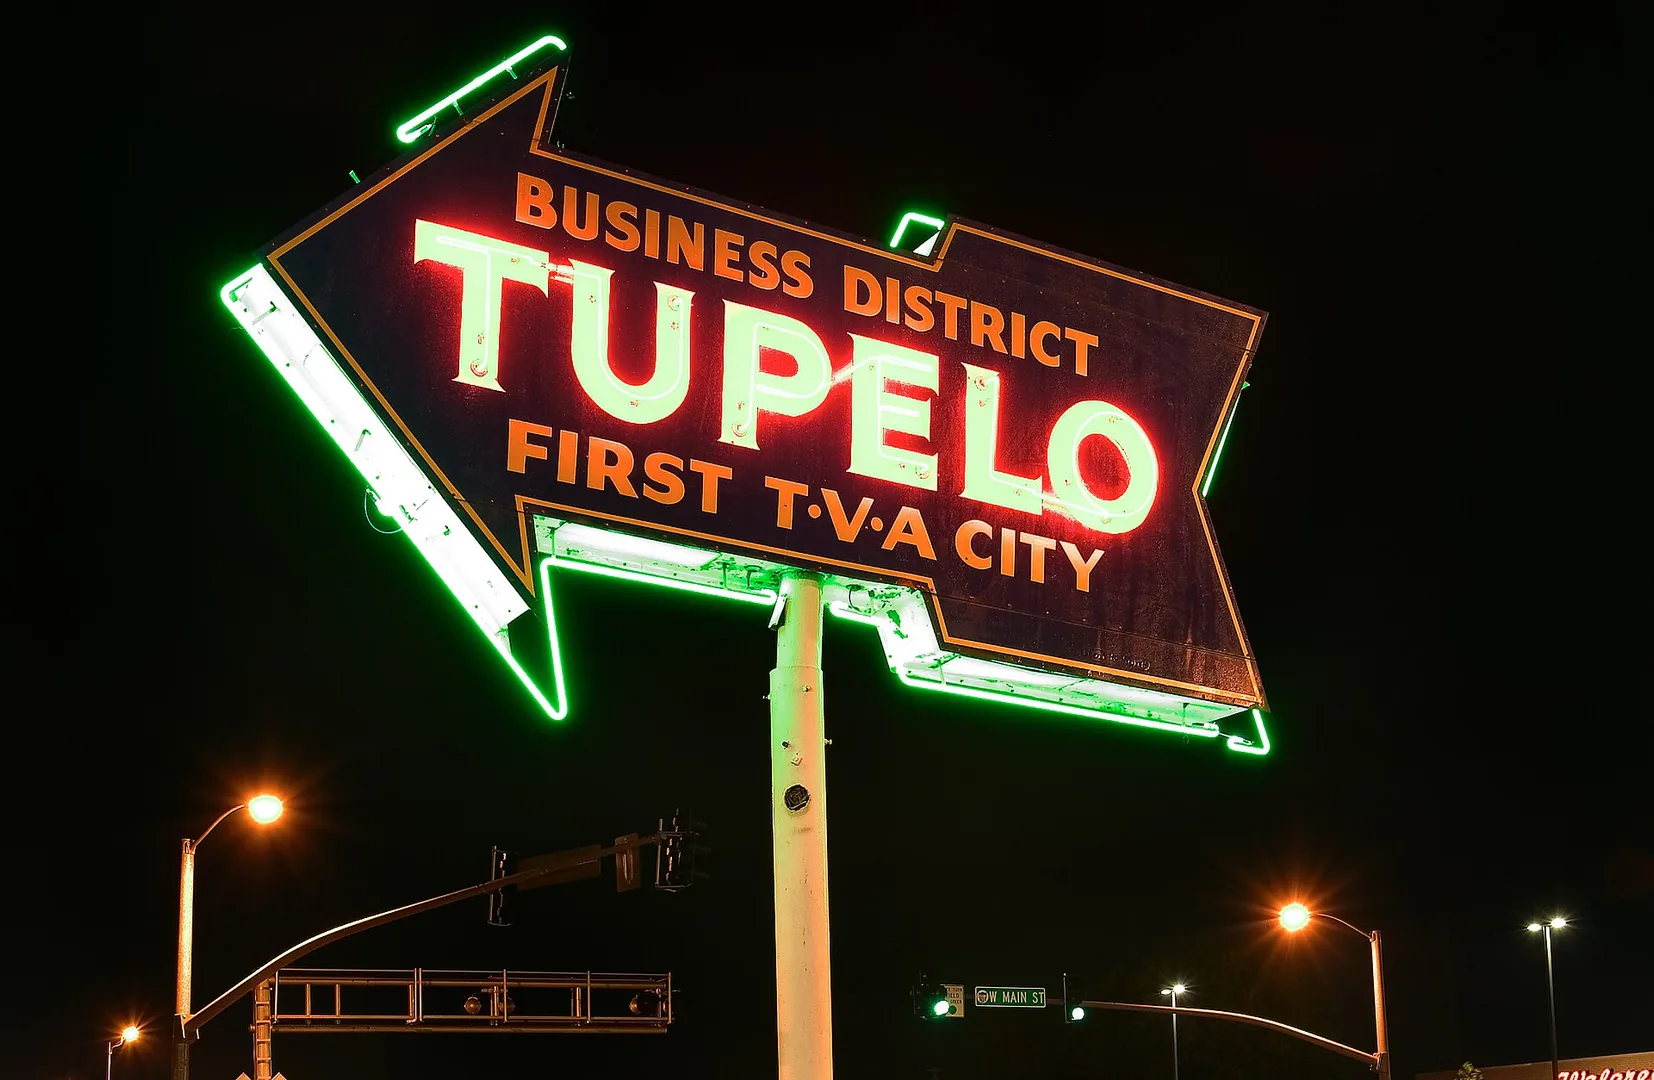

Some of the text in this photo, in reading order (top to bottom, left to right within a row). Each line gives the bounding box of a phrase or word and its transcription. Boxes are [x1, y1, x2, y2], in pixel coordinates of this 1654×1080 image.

[516, 172, 1099, 377] BUSINESS DISTRICT
[413, 218, 1159, 535] TUPELO
[507, 418, 733, 514] FIRST
[955, 520, 1105, 592] CITY
[989, 990, 1045, 1004] W MAIN ST
